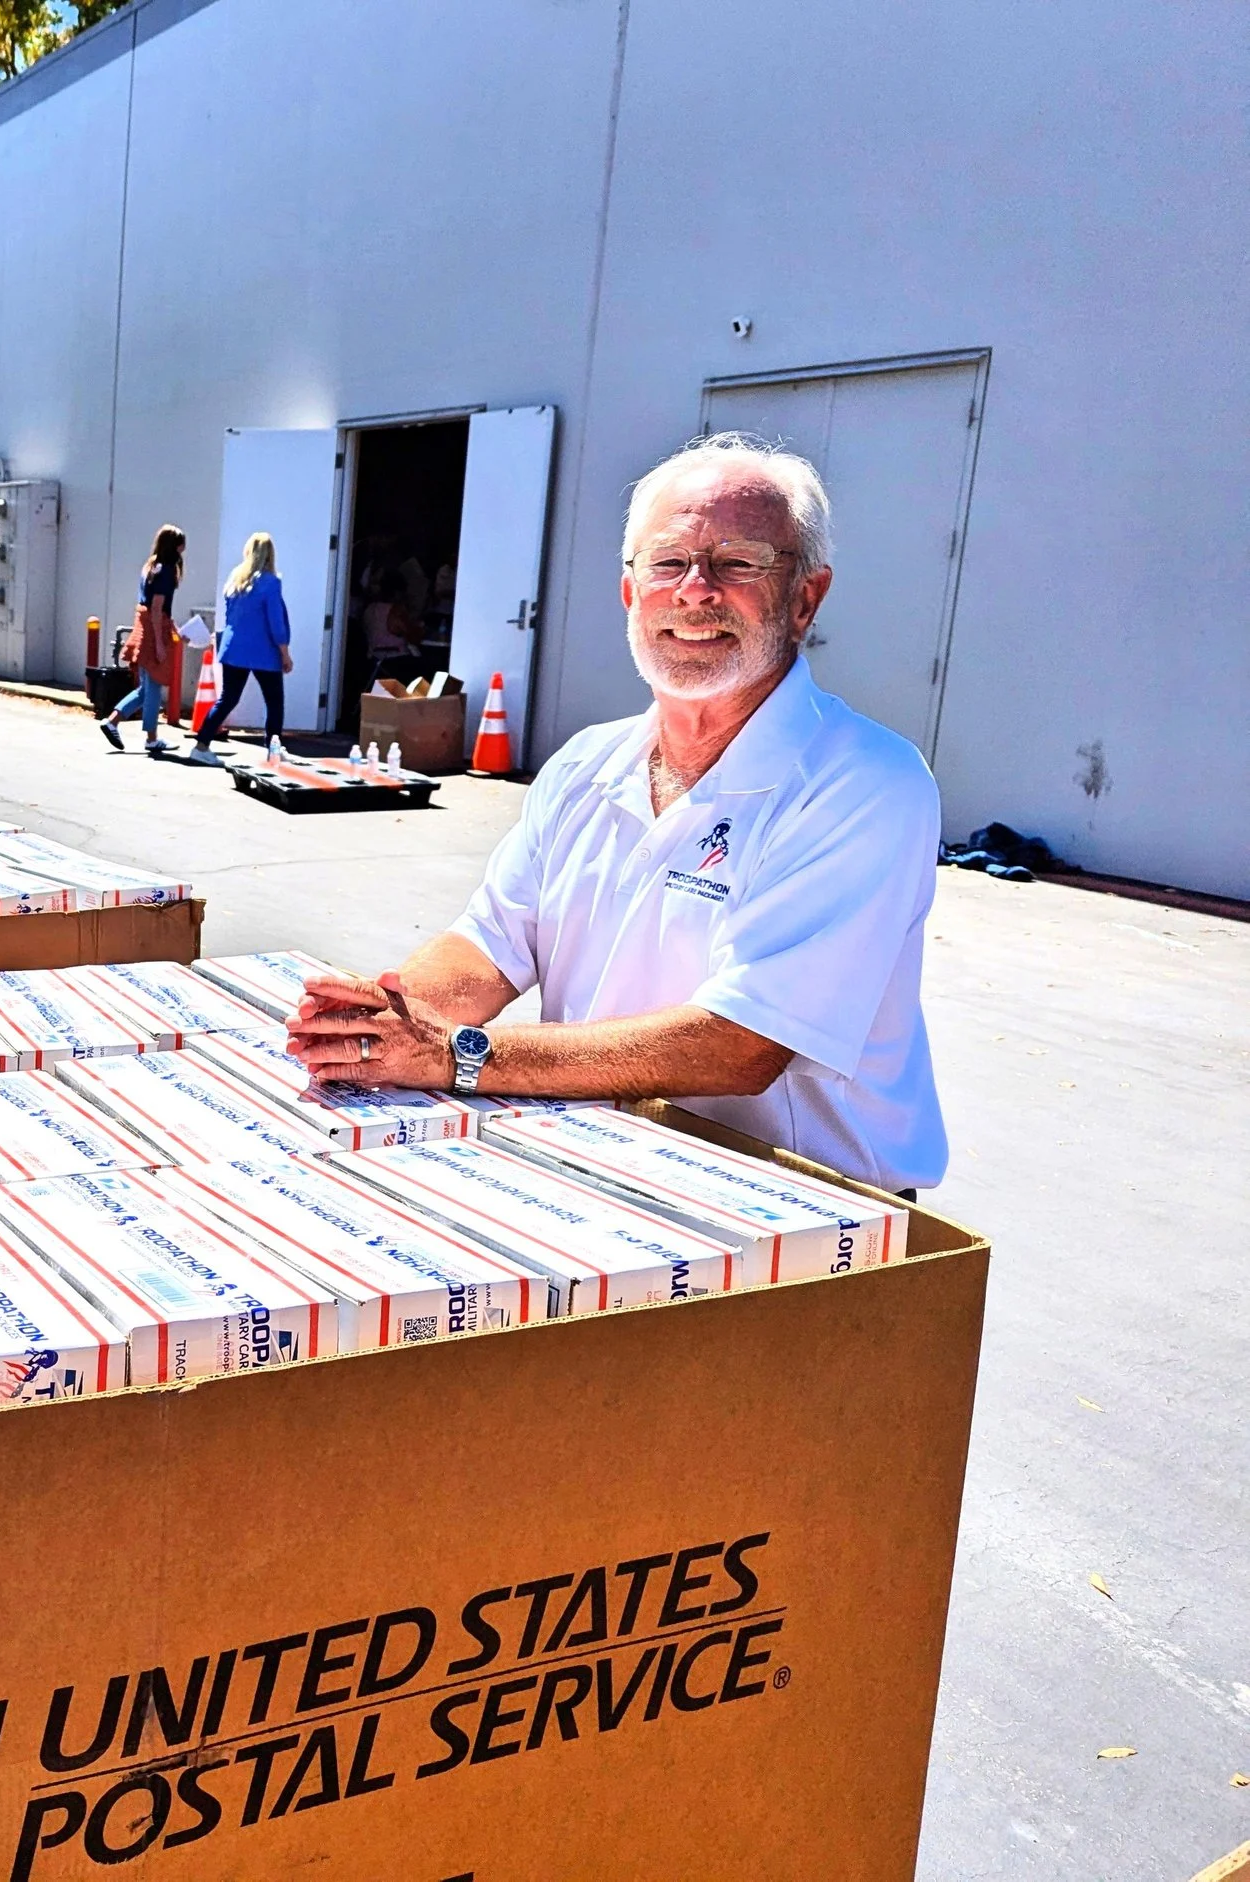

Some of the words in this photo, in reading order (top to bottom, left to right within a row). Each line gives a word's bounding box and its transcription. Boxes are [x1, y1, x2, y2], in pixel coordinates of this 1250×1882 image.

[667, 870, 731, 895] TROOPATHON
[697, 890, 724, 902] PACKAGES
[133, 1225, 222, 1280] TROOPATHON
[37, 1605, 436, 1774] UNITED
[447, 1533, 771, 1678] STATES
[10, 1731, 396, 1882] POSTAL
